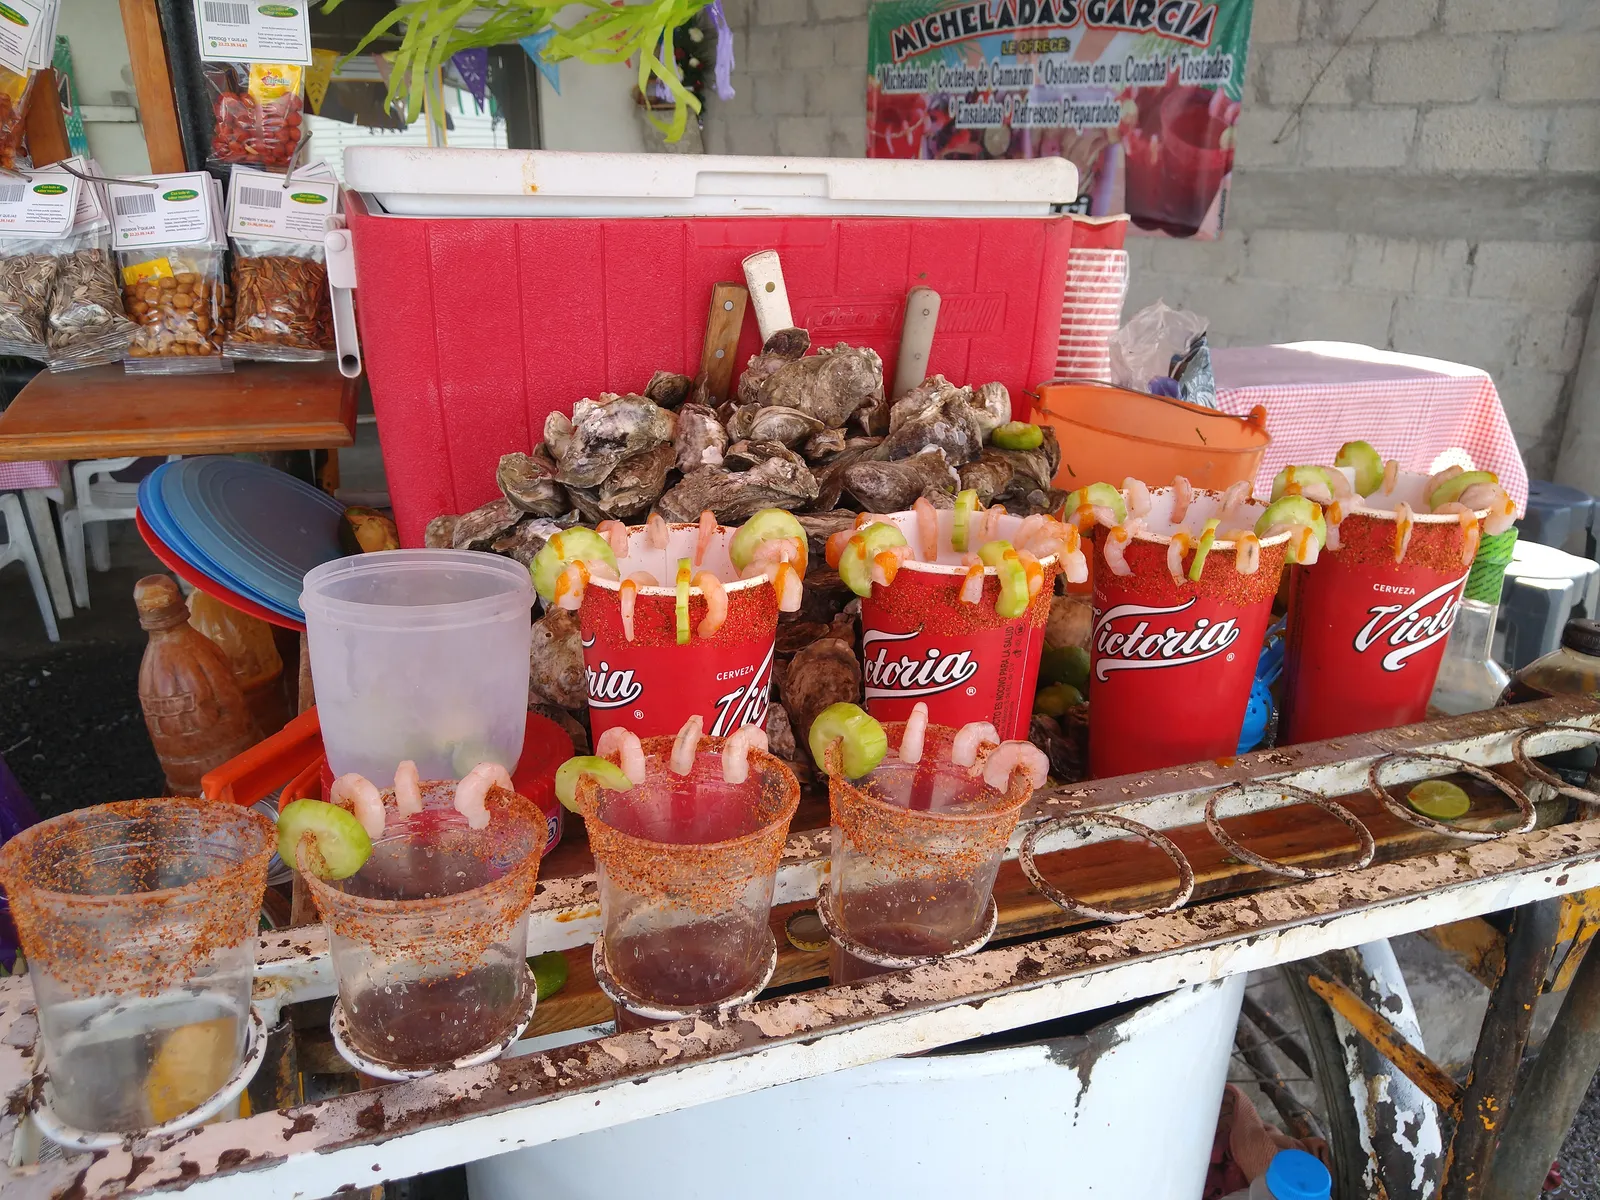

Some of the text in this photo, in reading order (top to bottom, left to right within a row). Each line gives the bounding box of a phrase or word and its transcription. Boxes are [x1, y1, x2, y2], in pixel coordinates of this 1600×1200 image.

[892, 0, 1214, 59] MICHELADAS GARCIA
[1001, 41, 1015, 55] LE
[938, 63, 974, 88] Cocteles
[977, 63, 988, 87] de
[1045, 58, 1089, 85] Ostiones
[1093, 64, 1106, 82] en
[1109, 63, 1121, 82] su
[1125, 54, 1166, 82] Concha
[1181, 50, 1231, 80] Tostadas
[957, 97, 1121, 130] Ensaladas Refrescos Preparados
[1373, 583, 1416, 595] CERVEZA
[1003, 626, 1014, 648] SALUD
[1002, 649, 1010, 657] LA
[716, 664, 755, 681] CERVEZA
[998, 659, 1009, 676] PARA
[996, 676, 1007, 701] NOCIVO
[994, 701, 1004, 710] ES
